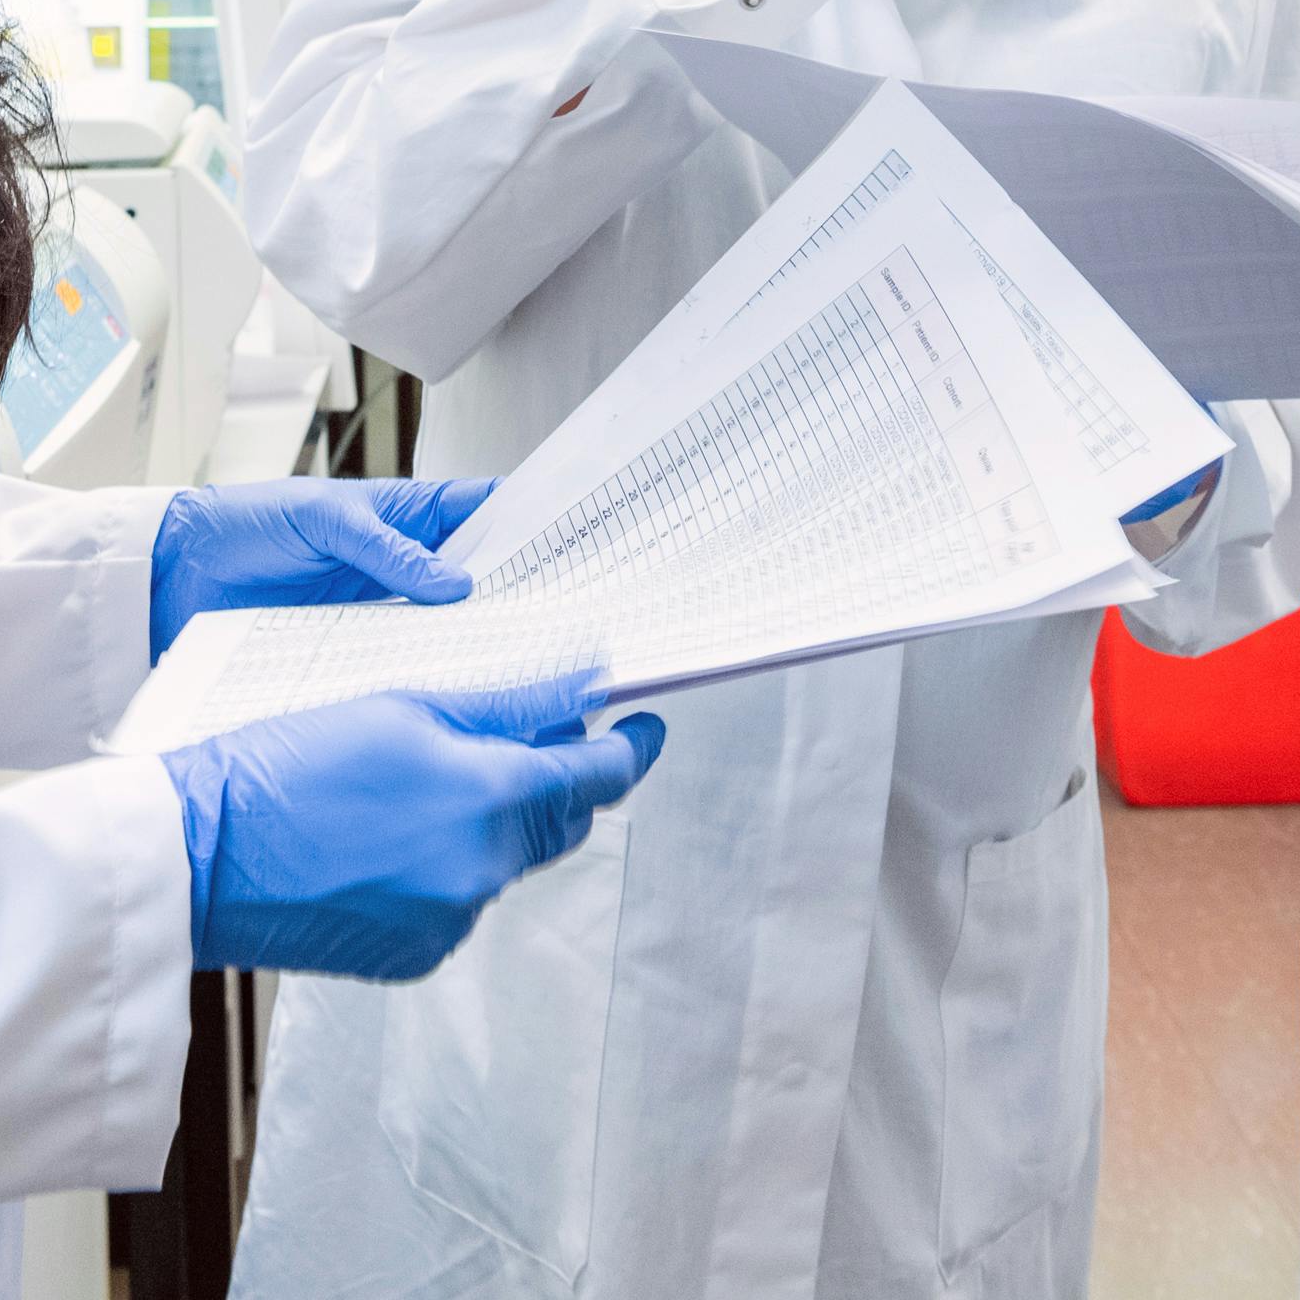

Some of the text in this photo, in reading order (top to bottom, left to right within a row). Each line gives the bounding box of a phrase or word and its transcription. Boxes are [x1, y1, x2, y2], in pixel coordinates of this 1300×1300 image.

[880, 267, 962, 408] Sample ID Patient ID Cohort
[726, 416, 735, 429] 12
[643, 480, 651, 492] 19
[628, 489, 638, 501] 20
[615, 498, 625, 510] 21
[602, 507, 612, 520] 22
[590, 516, 600, 529] 23
[578, 526, 588, 538] 24
[566, 535, 576, 548] 25
[554, 544, 564, 557] 26
[542, 554, 551, 564] 27
